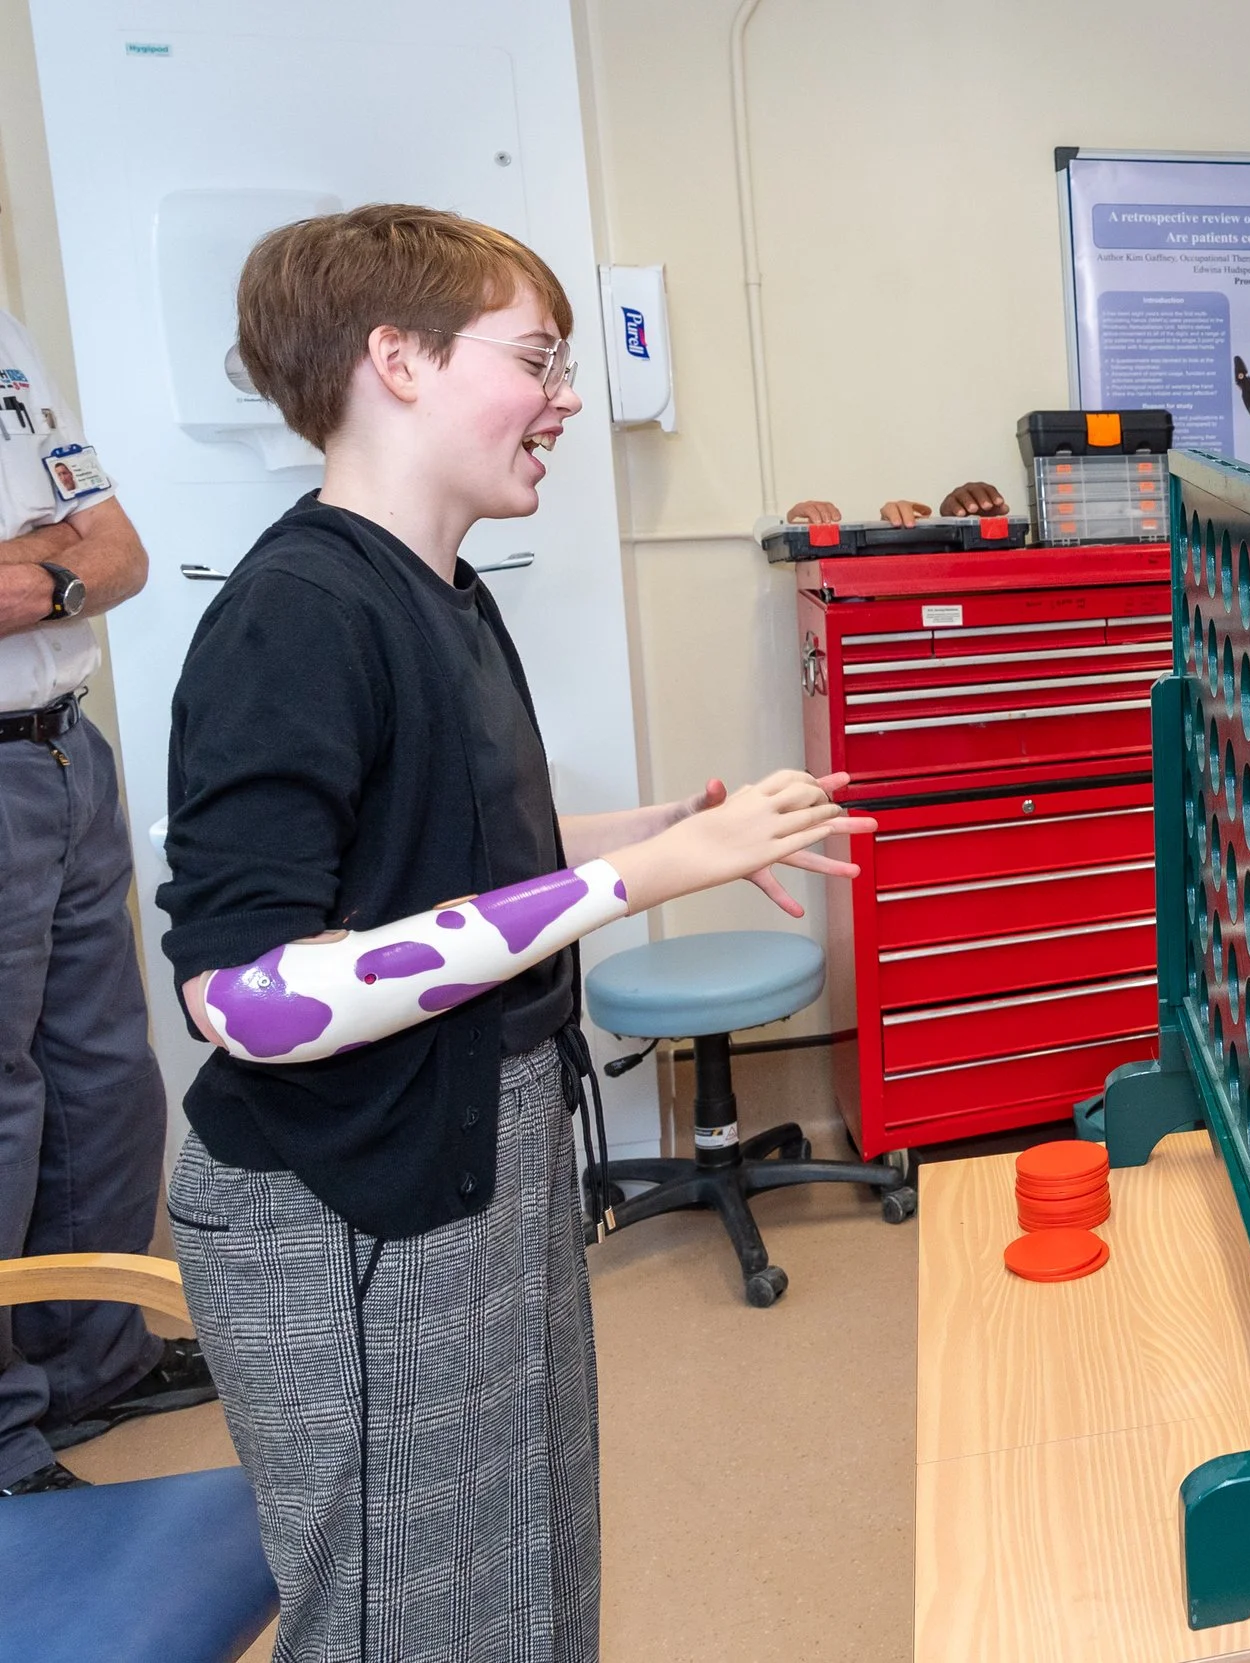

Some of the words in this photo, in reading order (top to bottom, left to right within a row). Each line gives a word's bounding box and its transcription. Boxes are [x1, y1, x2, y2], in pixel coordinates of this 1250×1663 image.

[1109, 211, 1119, 222] A
[1121, 211, 1199, 226] retrospective
[1202, 213, 1240, 224] review
[1166, 232, 1189, 243] Are
[1191, 232, 1239, 245] patients
[1097, 254, 1124, 262] Author
[1126, 254, 1143, 262] Kim
[1179, 254, 1230, 264] Occupational
[626, 312, 645, 355] Purell
